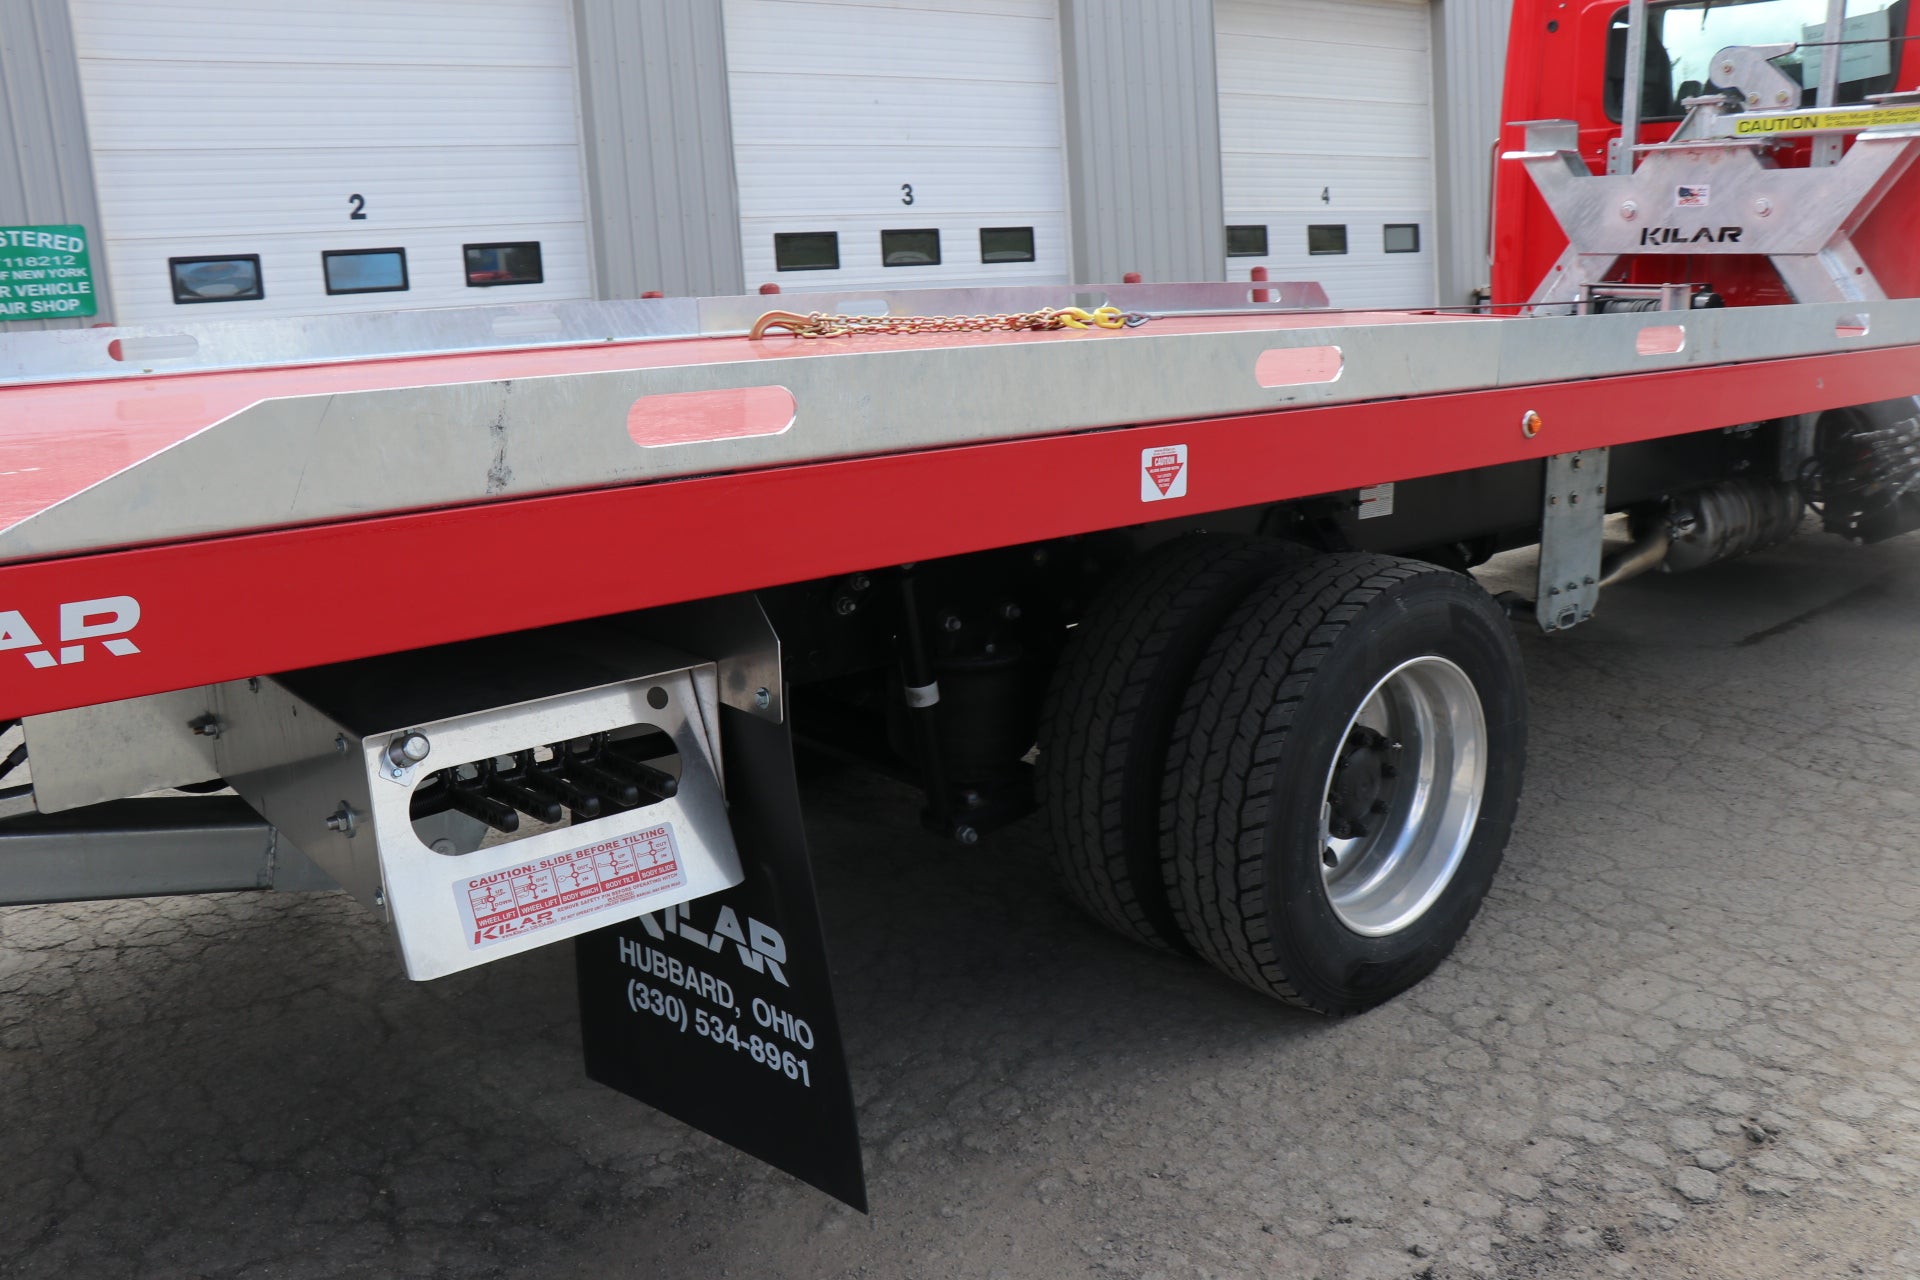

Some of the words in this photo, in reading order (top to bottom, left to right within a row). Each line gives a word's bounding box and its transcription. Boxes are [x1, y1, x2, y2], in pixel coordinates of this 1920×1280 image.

[1738, 116, 1818, 133] CAUTION
[901, 183, 914, 206] 3
[1320, 186, 1330, 205] 4
[349, 193, 367, 220] 2
[1640, 226, 1743, 246] KILAR
[0, 255, 76, 268] 118212
[12, 269, 45, 280] NEW
[47, 267, 88, 279] YORK
[14, 281, 91, 297] VEHICLE
[31, 298, 80, 313] SHOP
[469, 864, 536, 888] CAUTION:
[539, 853, 573, 868] SLIDE
[576, 841, 620, 858] BEFORE
[622, 827, 665, 844] TILTING
[641, 869, 657, 878] BODY
[659, 864, 675, 873] SLIDE
[605, 880, 622, 889] BODY
[611, 887, 632, 896] BEFORE
[562, 892, 580, 901] BODY
[581, 887, 599, 896] WINCH
[521, 904, 543, 914] WHEEL
[478, 916, 502, 927] WHEEL
[503, 911, 516, 919] LIFT
[474, 910, 553, 945] KILAR
[619, 936, 741, 1019] HUBBARD,
[752, 997, 815, 1050] OHIO
[627, 978, 688, 1033] (330)
[694, 1008, 811, 1088] 534-8961
